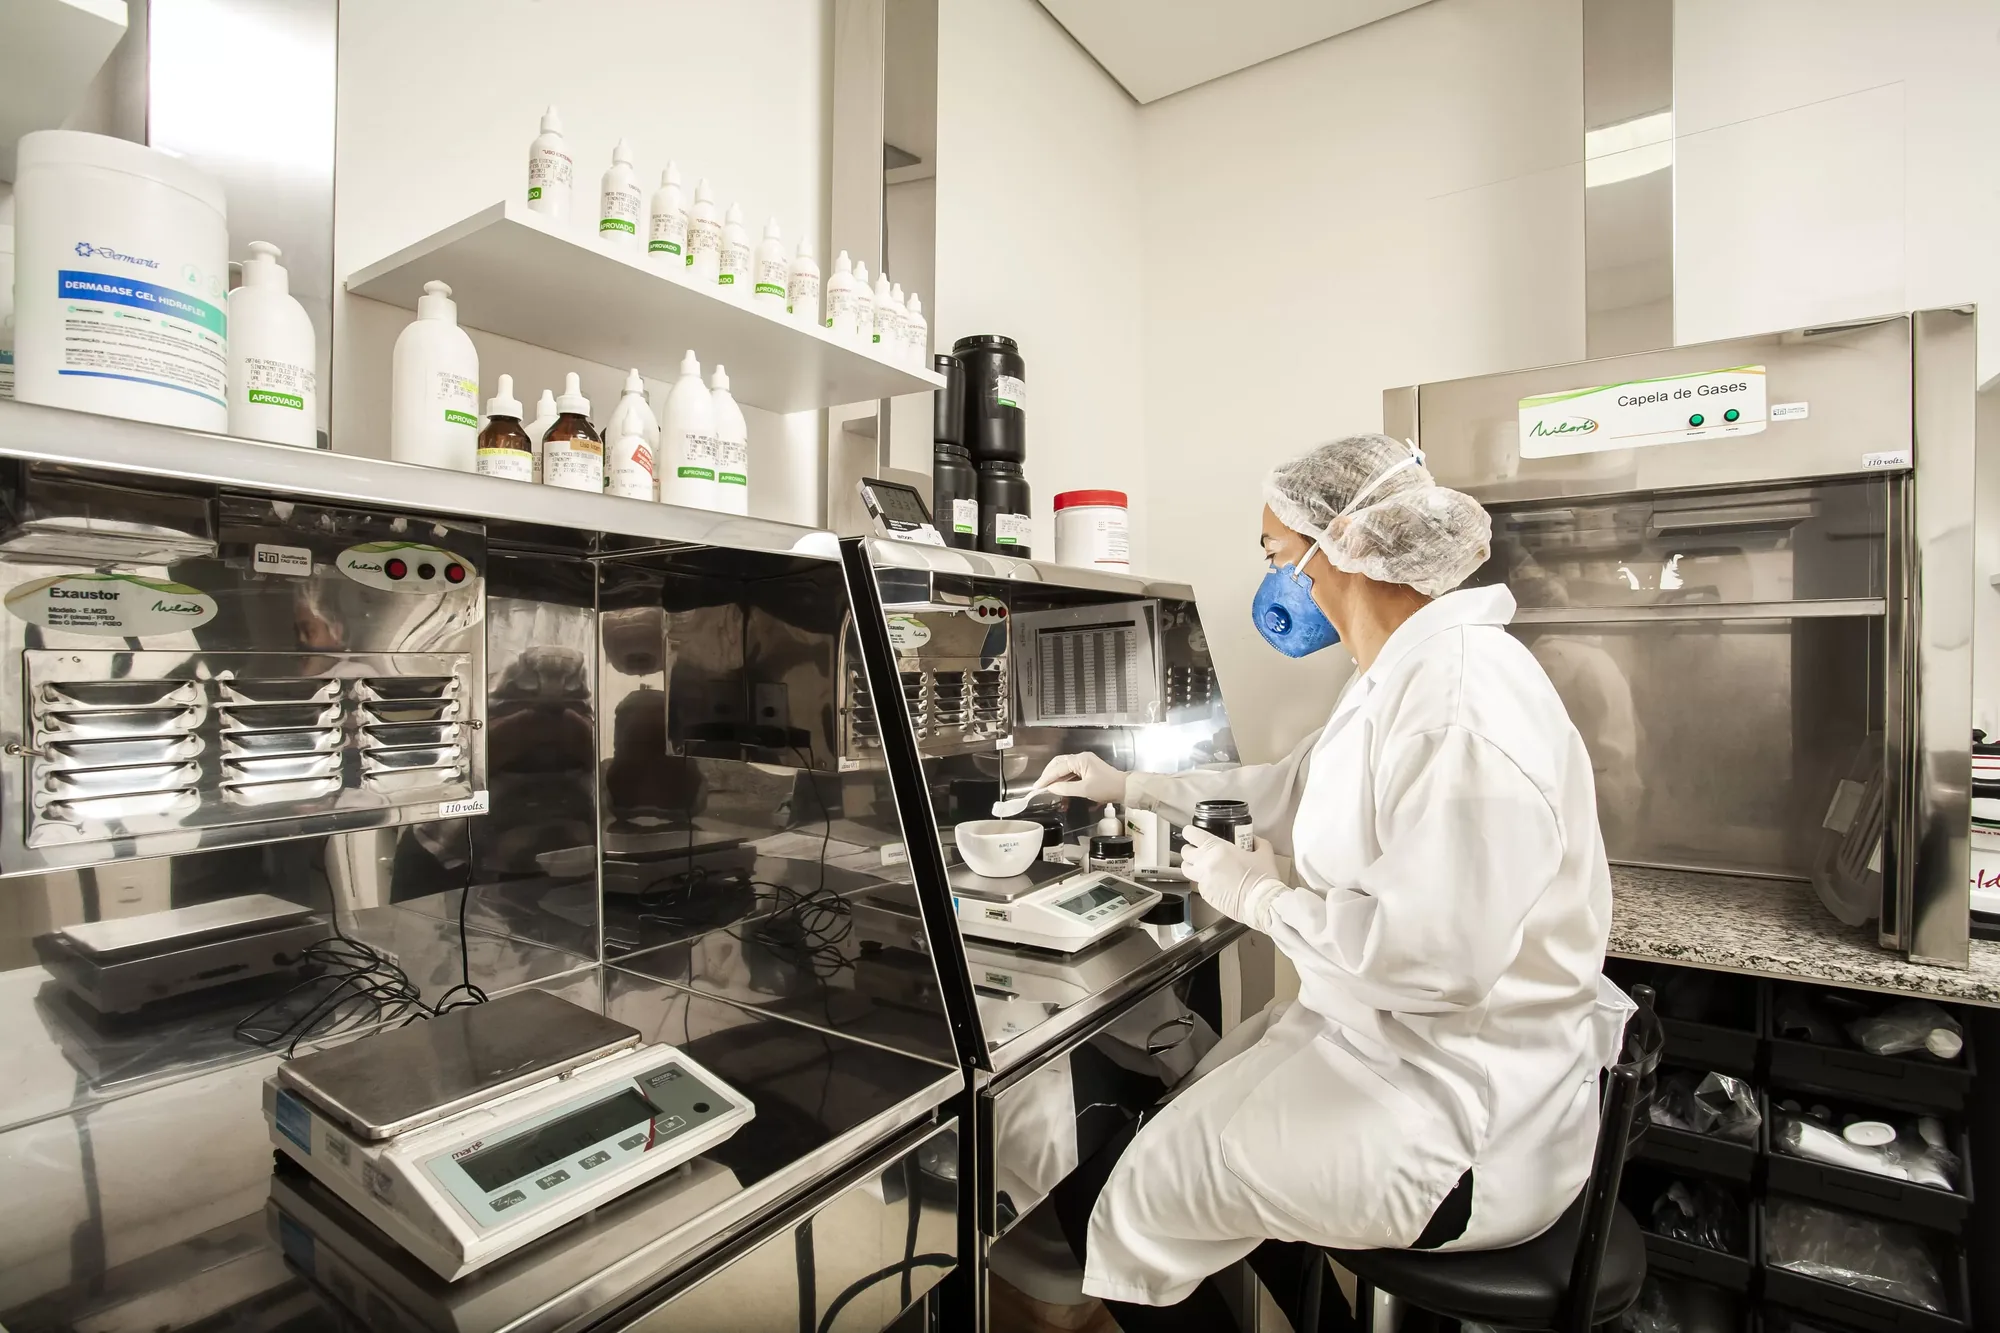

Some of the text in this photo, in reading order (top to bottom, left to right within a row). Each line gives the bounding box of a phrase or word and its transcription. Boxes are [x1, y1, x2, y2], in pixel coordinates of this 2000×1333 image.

[65, 281, 206, 318] DERMABASE GEL HIDRAFLEX
[252, 394, 301, 408] APROVADO
[1617, 382, 1747, 407] Capela de Gases
[49, 587, 120, 601] Exaustor
[445, 803, 461, 813] 110
[451, 1141, 484, 1160] marte
[542, 1175, 557, 1183] BAL
